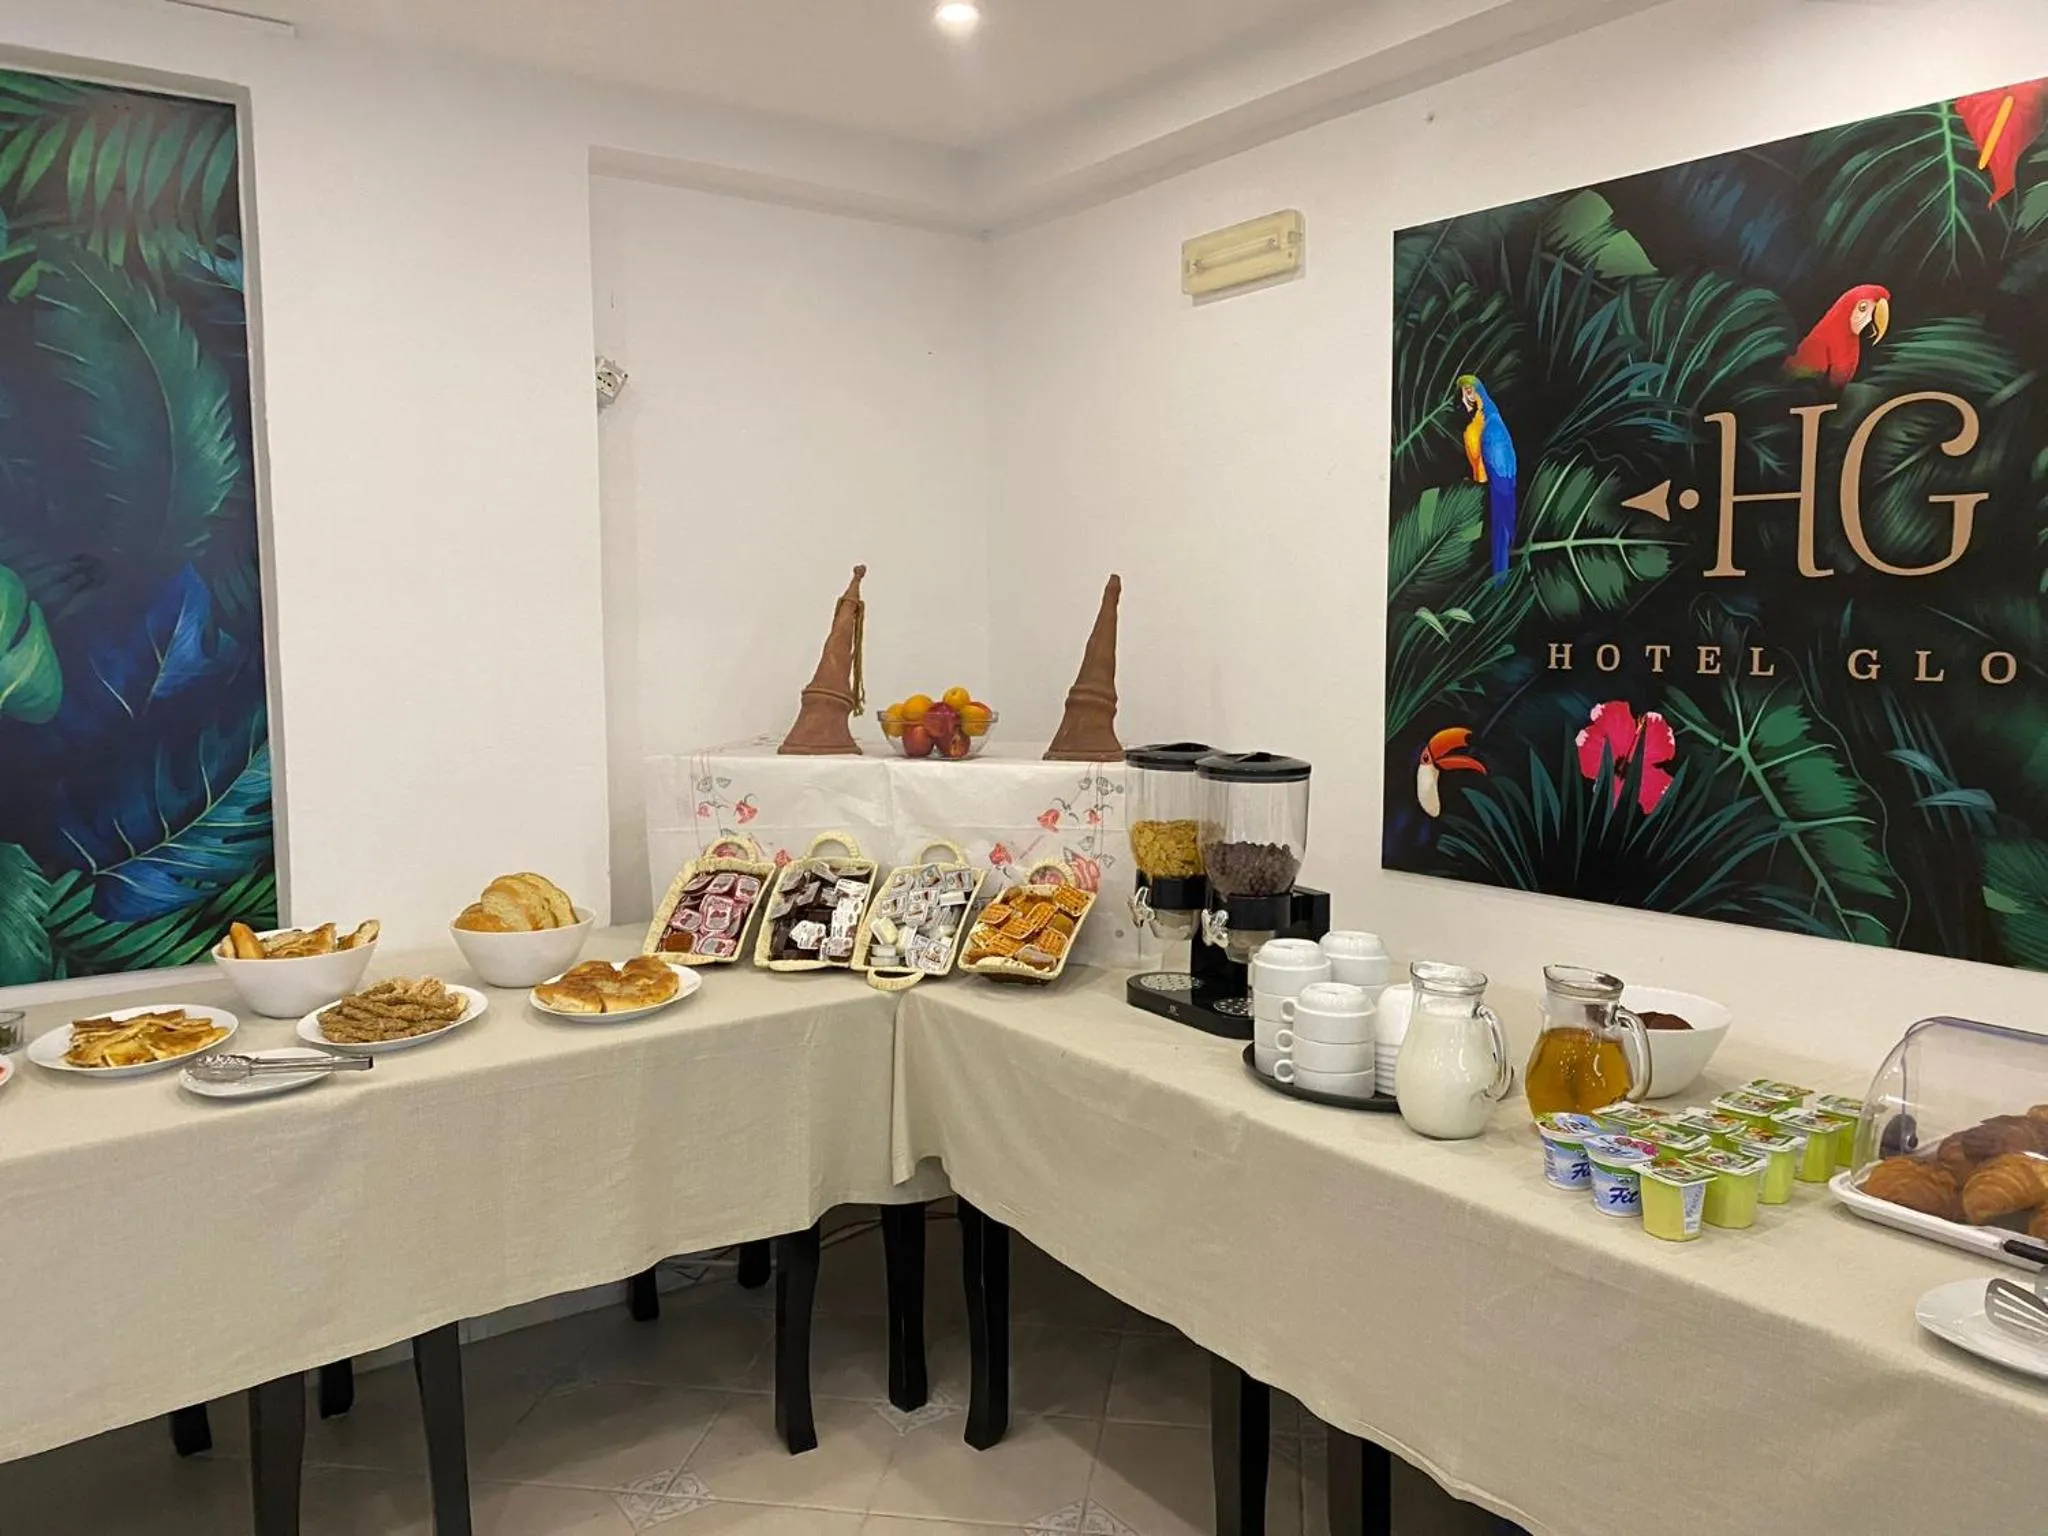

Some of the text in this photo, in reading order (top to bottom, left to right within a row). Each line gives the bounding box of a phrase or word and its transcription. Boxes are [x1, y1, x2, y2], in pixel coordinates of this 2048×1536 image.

[1703, 391, 1989, 578] HG
[1547, 642, 2017, 684] HOTEL GLO
[1608, 1187, 1640, 1204] Fit
